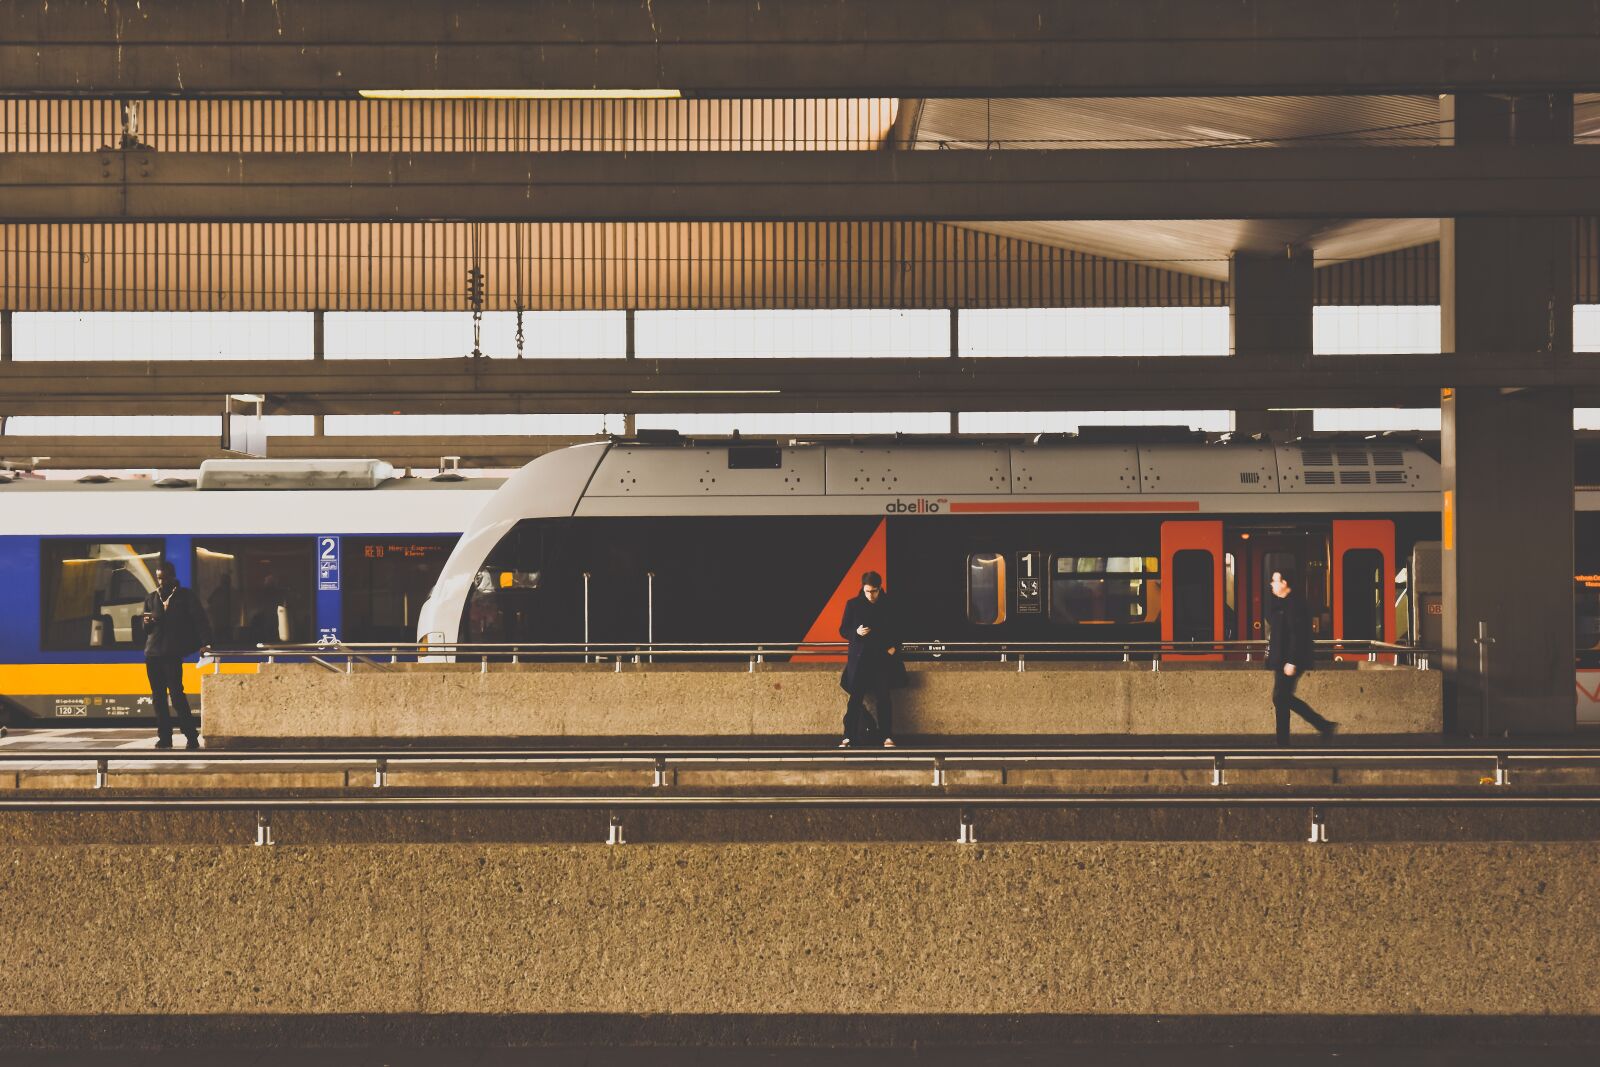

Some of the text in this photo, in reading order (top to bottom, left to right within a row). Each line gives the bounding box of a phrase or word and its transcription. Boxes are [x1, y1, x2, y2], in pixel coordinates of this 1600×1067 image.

[886, 498, 939, 513] abellio
[321, 538, 335, 559] 2
[1021, 553, 1032, 577] 1
[59, 707, 72, 715] 120
